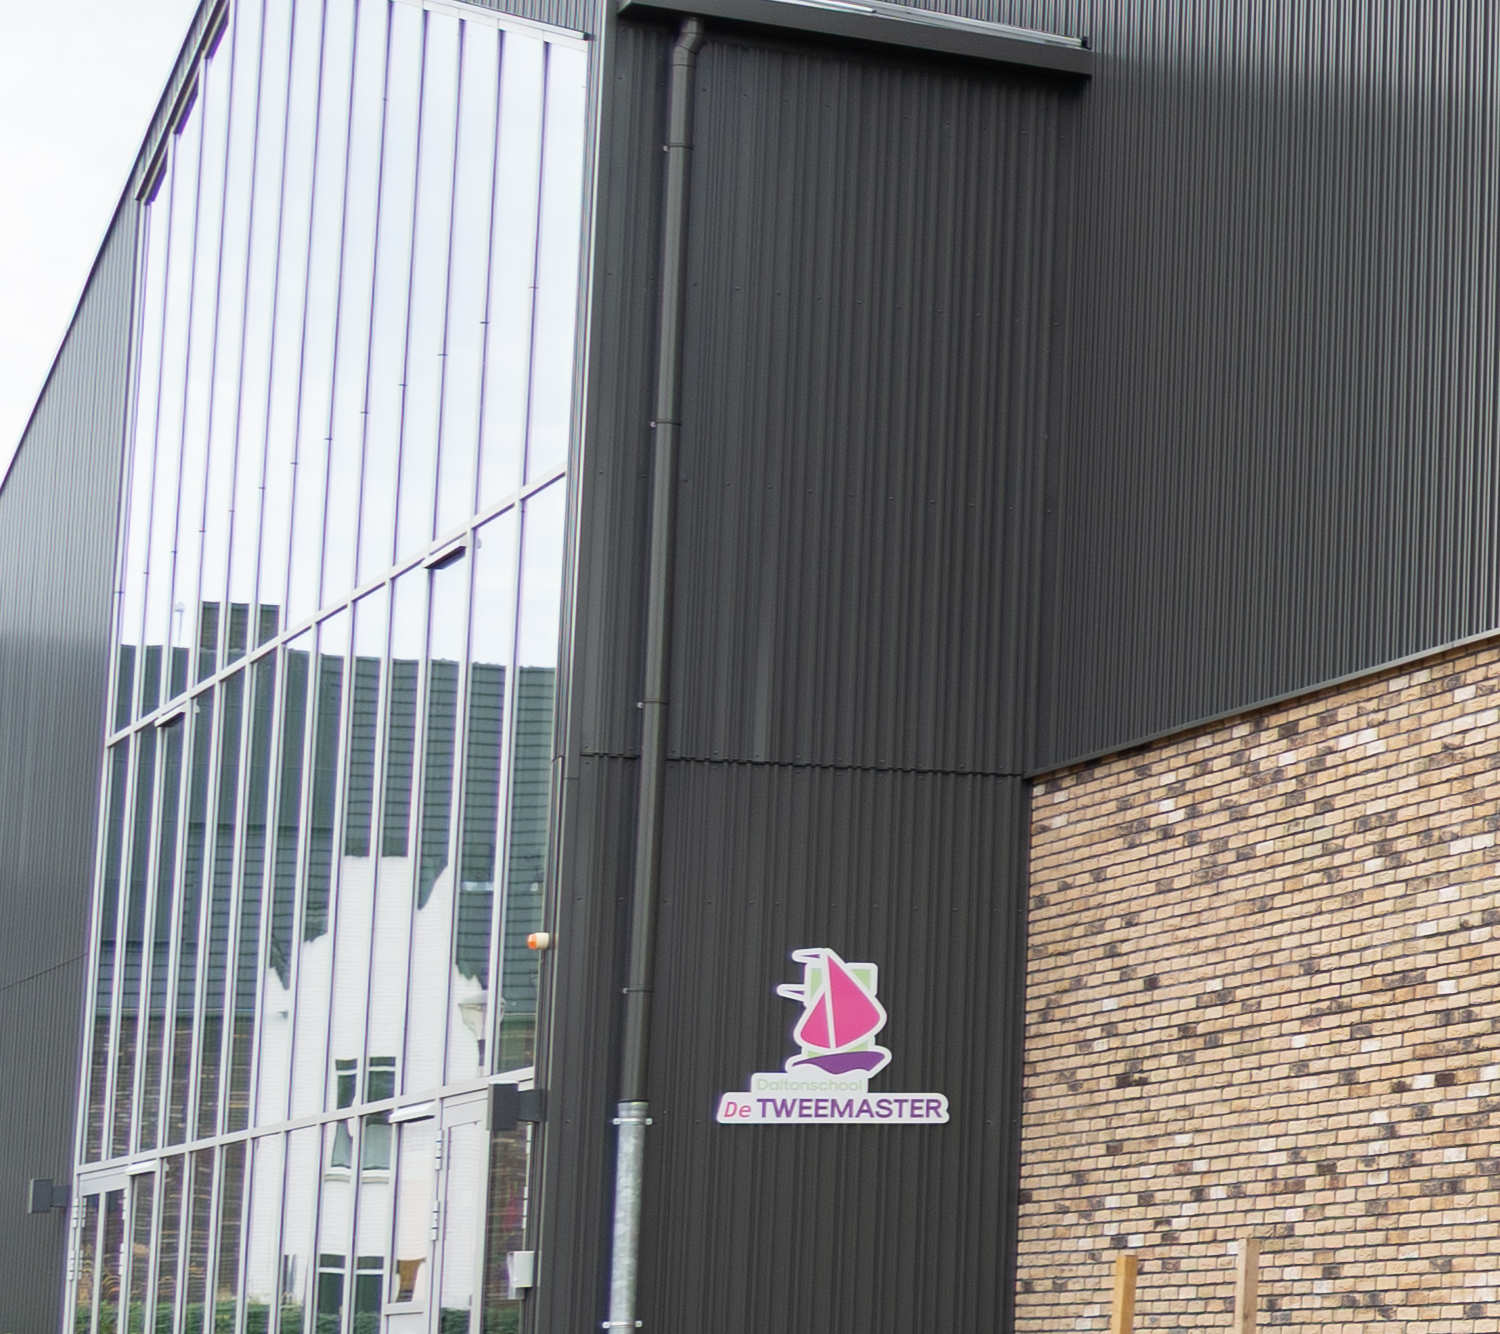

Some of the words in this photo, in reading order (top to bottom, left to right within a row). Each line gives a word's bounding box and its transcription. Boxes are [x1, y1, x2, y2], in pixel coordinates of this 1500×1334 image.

[757, 1078, 862, 1092] Daltonschool
[724, 1101, 751, 1118] De
[756, 1098, 943, 1118] TWEEMASTER
